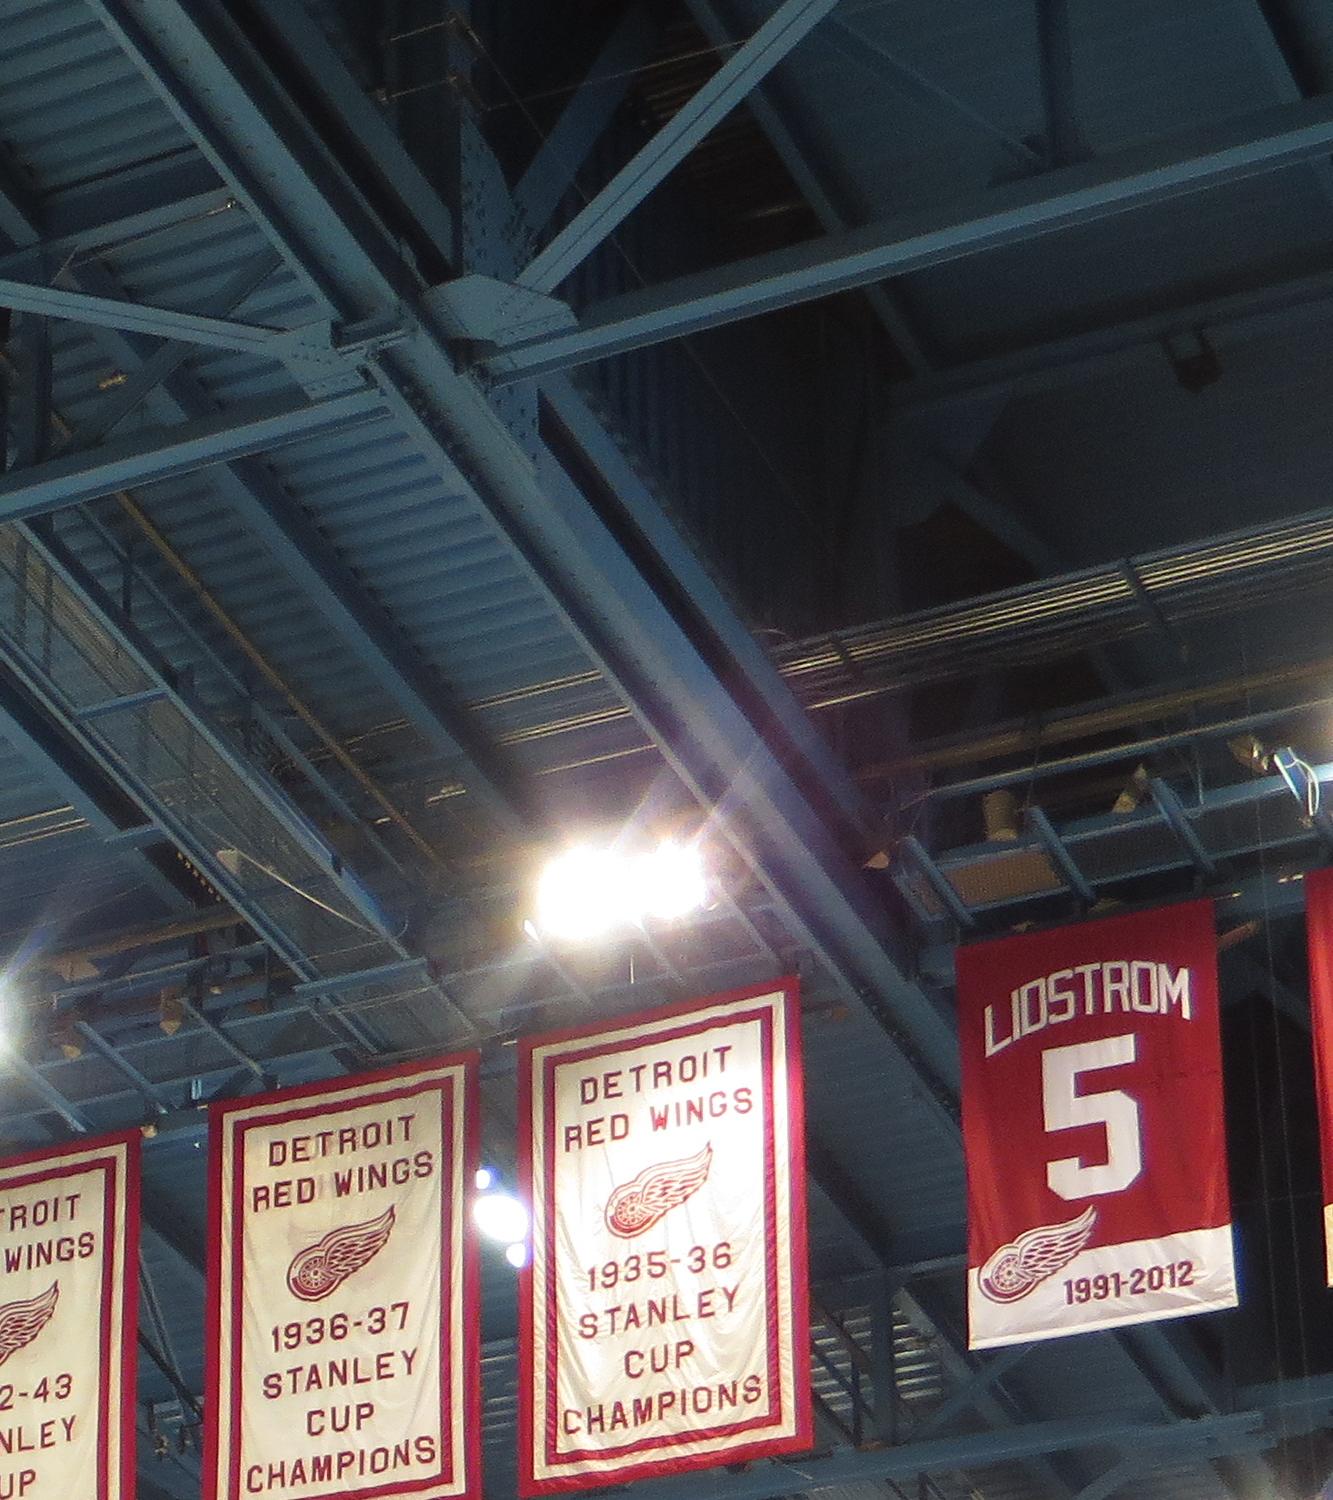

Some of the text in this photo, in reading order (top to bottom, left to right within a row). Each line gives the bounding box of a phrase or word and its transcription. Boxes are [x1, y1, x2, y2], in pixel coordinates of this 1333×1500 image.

[984, 961, 1191, 1058] LIDSTROM
[581, 1046, 732, 1106] DETROIT
[268, 1115, 416, 1167] DETROIT
[564, 1088, 753, 1152] RED WINGS
[1042, 1034, 1141, 1200] 5
[253, 1151, 433, 1212] RED WINGS
[5, 1232, 95, 1272] WINGS
[588, 1243, 731, 1291] 1935-36
[1064, 1261, 1194, 1305] 1991-2012
[272, 1302, 409, 1352] 1936-37
[578, 1284, 740, 1338] STANLEY
[262, 1348, 418, 1399] STANLEY
[624, 1341, 694, 1379] CUP
[307, 1403, 374, 1436] CUP
[563, 1376, 762, 1435] CHAMPIONS
[247, 1436, 436, 1492] CHAMPIONS
